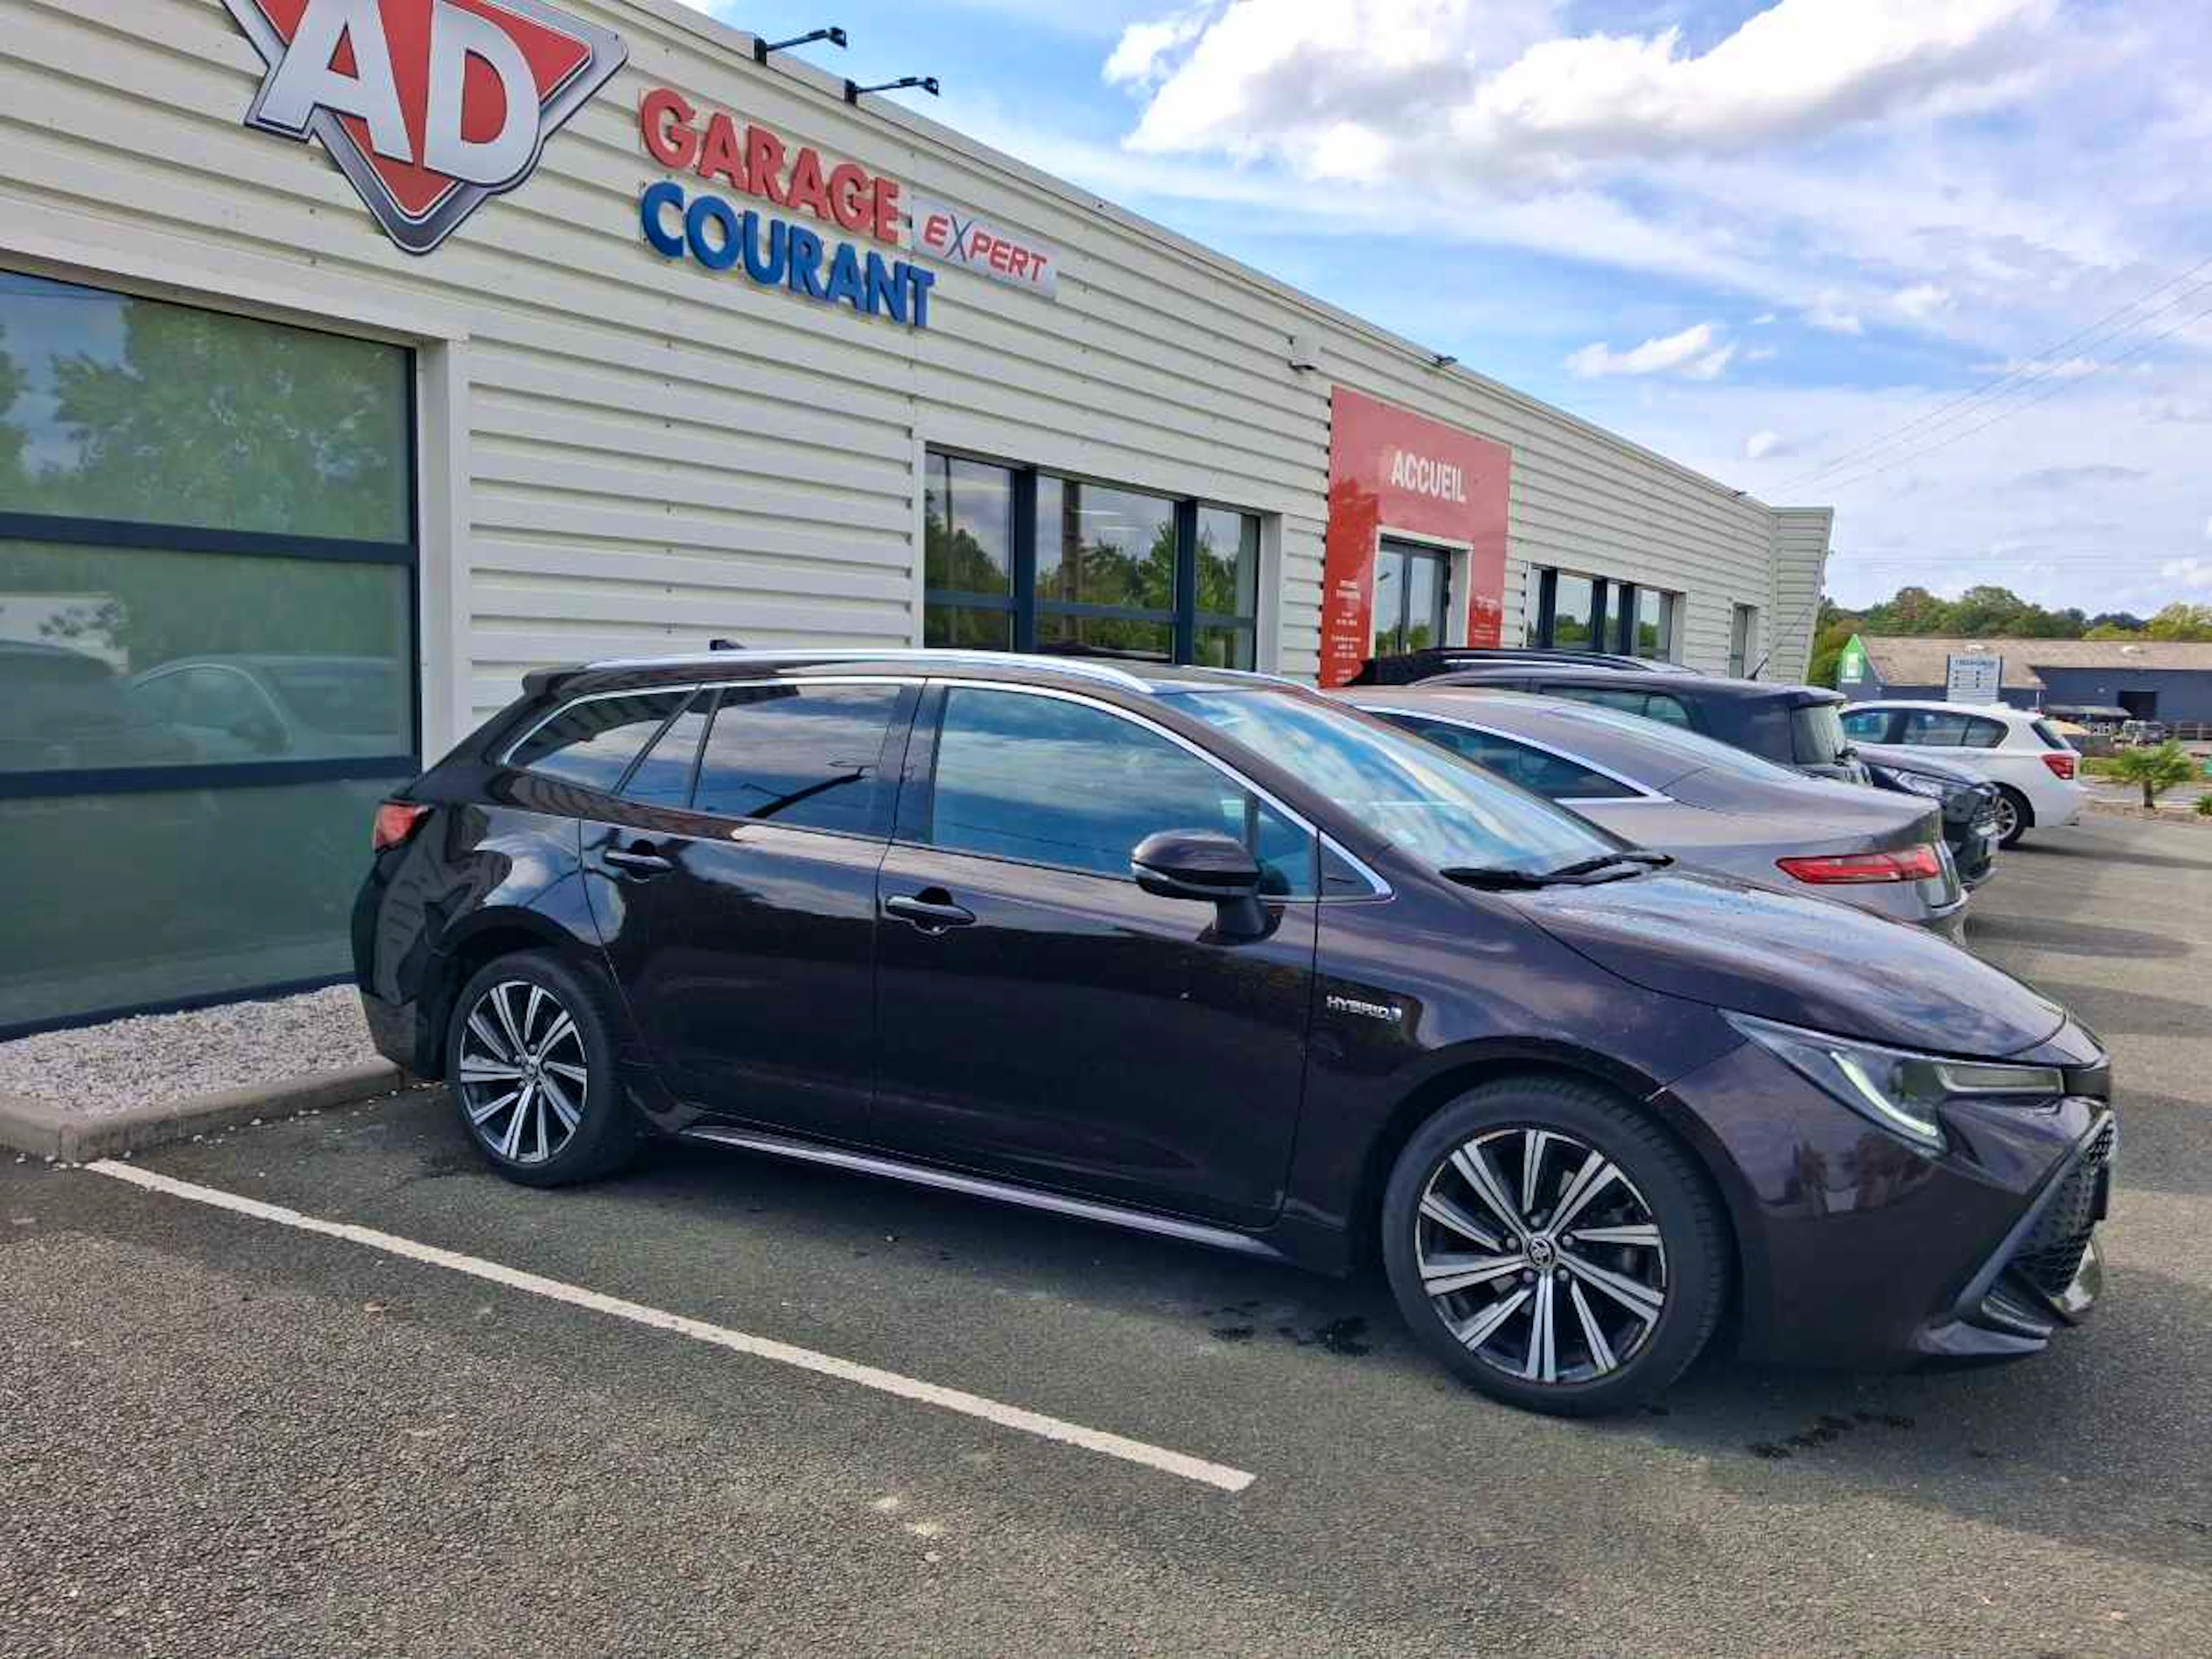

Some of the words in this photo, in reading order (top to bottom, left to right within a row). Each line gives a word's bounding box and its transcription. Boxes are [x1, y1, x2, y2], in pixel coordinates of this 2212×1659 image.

[257, 0, 540, 185] AD
[640, 88, 900, 244] GARAGE
[640, 181, 935, 327] COURANT
[1391, 449, 1467, 502] ACCUEIL
[1326, 995, 1389, 1020] HYBRID
